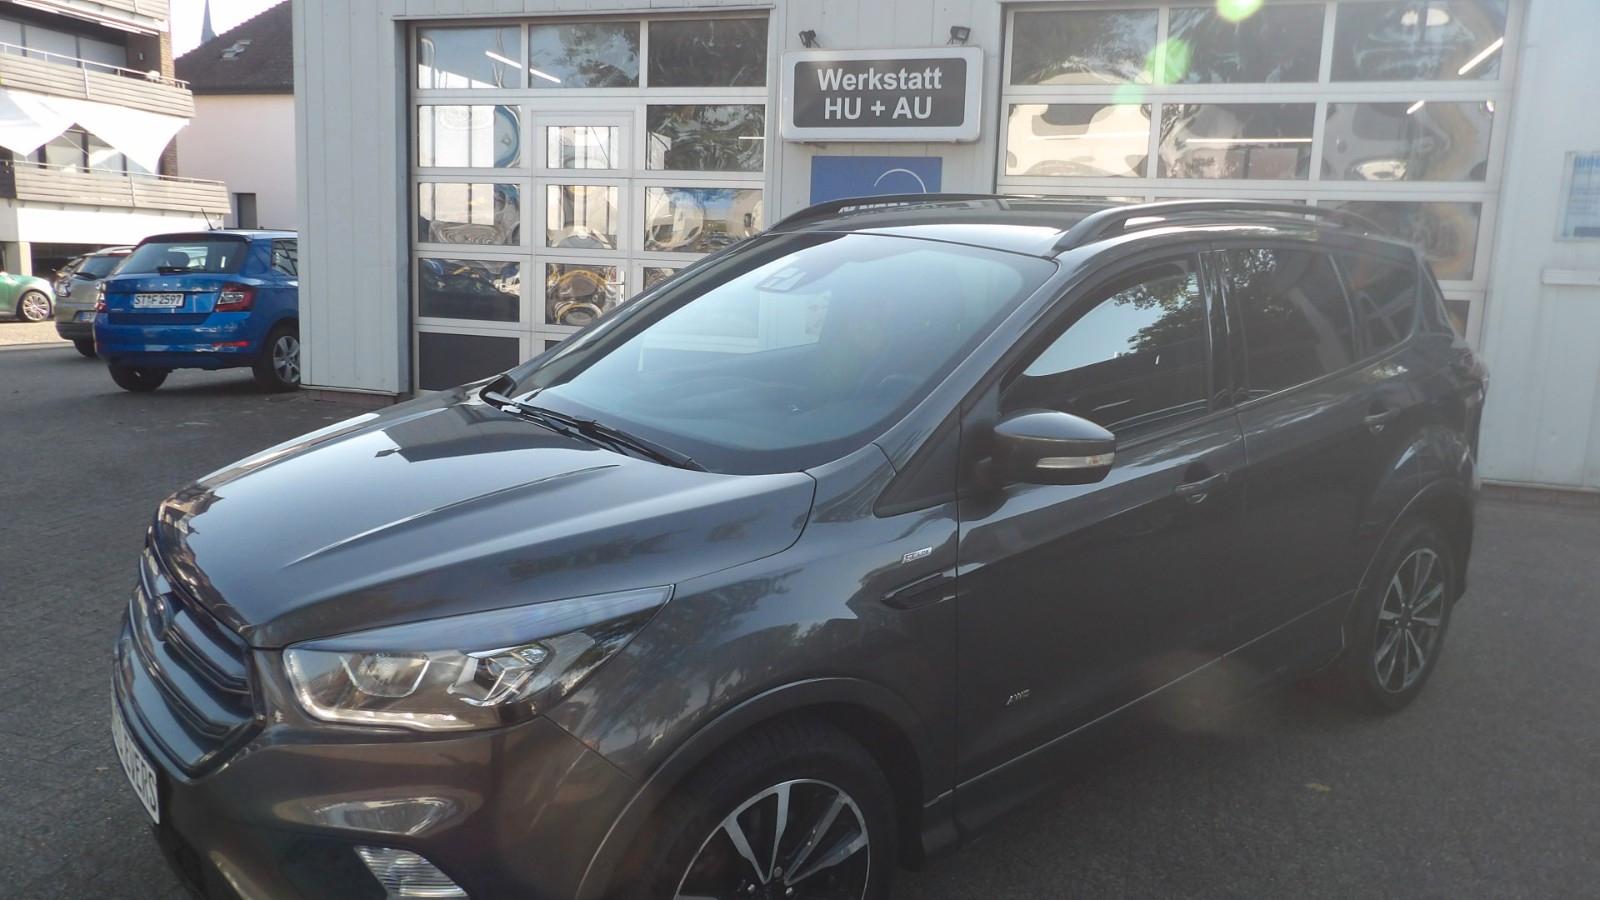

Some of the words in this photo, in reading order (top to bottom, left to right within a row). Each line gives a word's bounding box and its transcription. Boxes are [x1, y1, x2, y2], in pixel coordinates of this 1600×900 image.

[817, 67, 943, 91] Werkstatt
[824, 97, 862, 120] HU
[870, 100, 886, 116] +
[892, 96, 932, 120] AU
[159, 294, 182, 305] 2597
